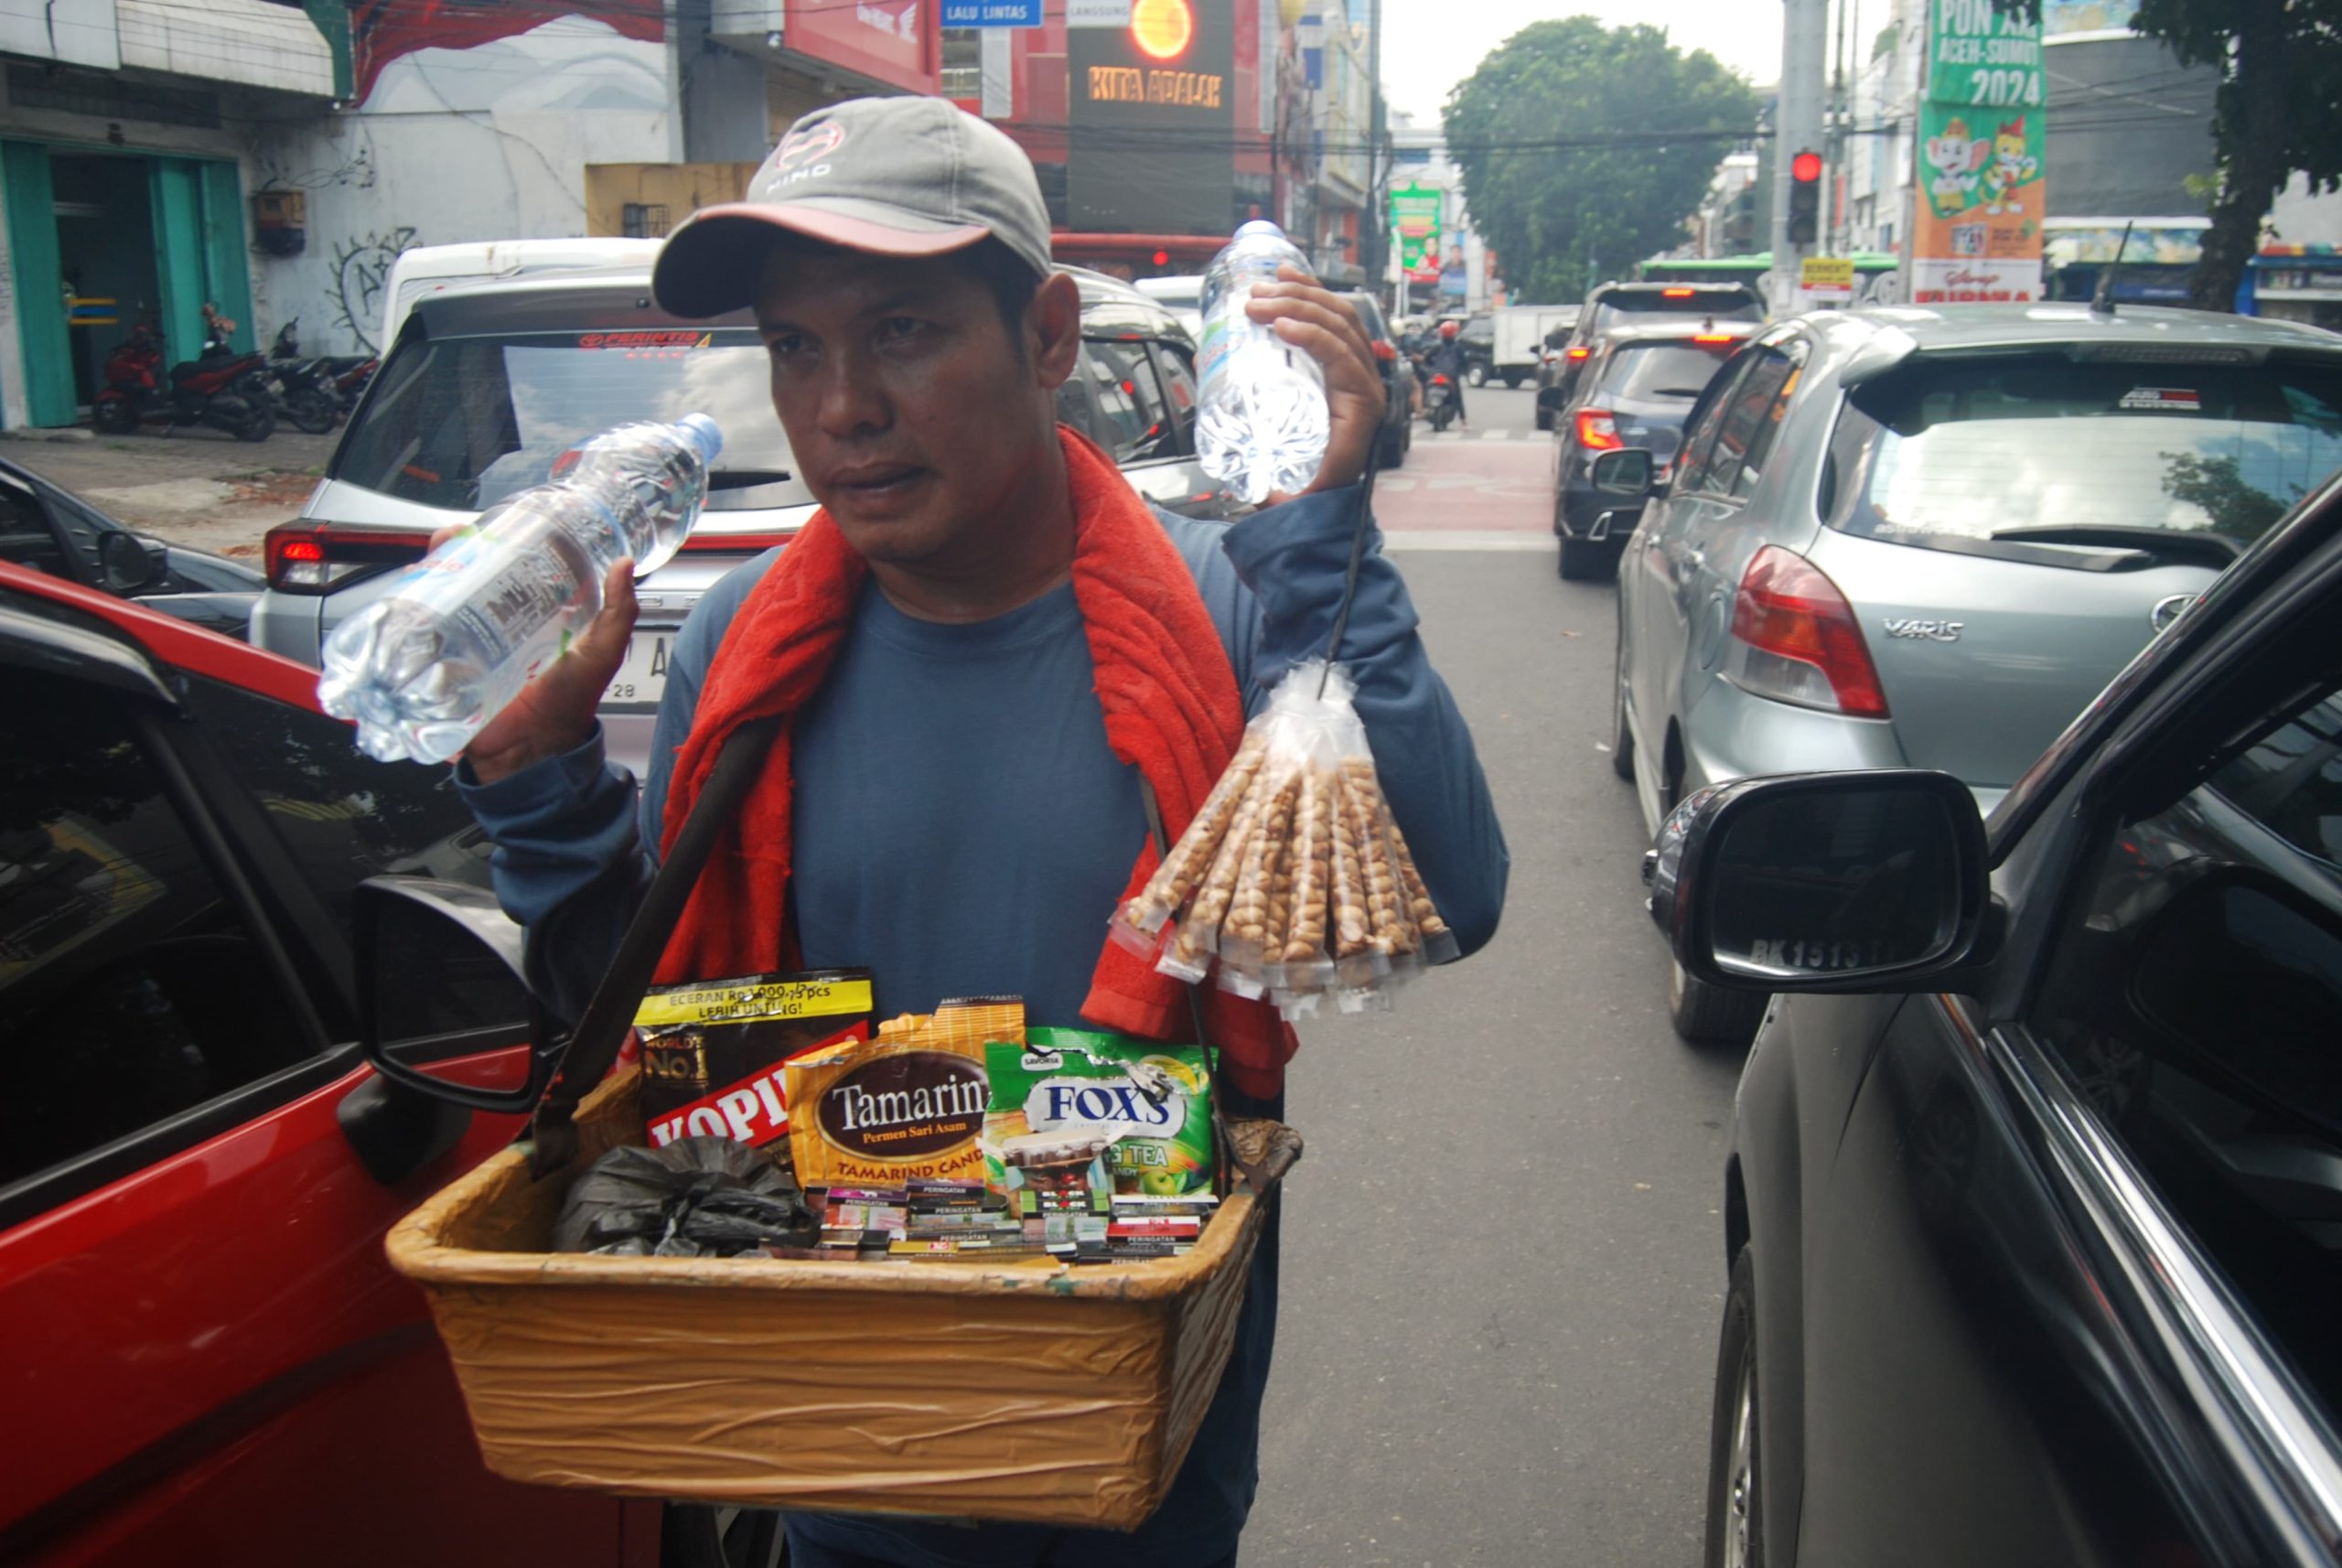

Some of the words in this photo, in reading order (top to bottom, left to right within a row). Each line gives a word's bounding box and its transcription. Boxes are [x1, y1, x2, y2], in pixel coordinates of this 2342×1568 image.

[947, 6, 978, 20] LALU
[983, 5, 1027, 20] LINTAS
[1939, 0, 1993, 36] PON
[1939, 37, 2038, 65] ACEH-SUMUT
[1089, 66, 1144, 102] KITA
[1971, 69, 2040, 107] 2024
[605, 330, 700, 346] PERINTIS
[1883, 618, 1964, 641] YARIS
[670, 992, 724, 1006] ECERAN
[833, 1073, 987, 1131] Tamarin
[1044, 1086, 1170, 1125] FOXS
[863, 1131, 908, 1144] Permen
[908, 1125, 933, 1138] Sari
[935, 1120, 967, 1134] Asam
[838, 1160, 933, 1181] TAMARIND
[939, 1148, 984, 1175] CAND
[1128, 1144, 1168, 1166] TEA
[1112, 1166, 1138, 1177] ANDY
[922, 1186, 967, 1194] PERINGATAN
[844, 1198, 889, 1207] PERINGATAN
[935, 1207, 983, 1215] PERINGATAN
[940, 1234, 988, 1242] PERINGATAN
